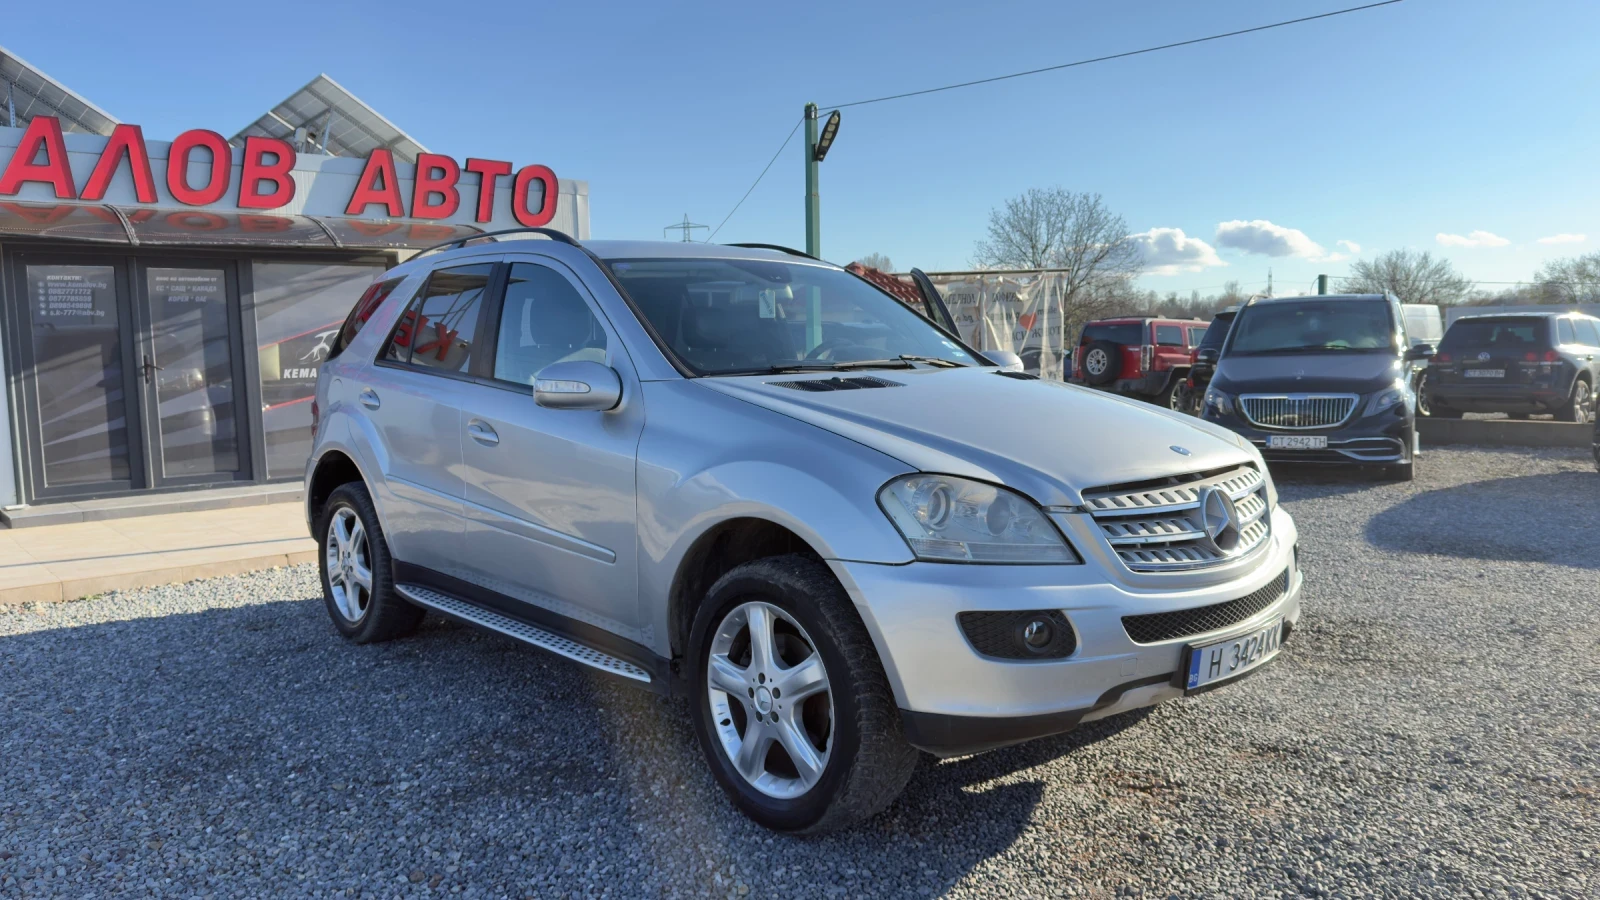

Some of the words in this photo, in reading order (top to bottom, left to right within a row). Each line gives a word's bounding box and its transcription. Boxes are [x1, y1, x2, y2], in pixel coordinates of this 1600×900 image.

[344, 148, 559, 228] АВТО
[1272, 437, 1284, 446] CT
[1287, 437, 1311, 447] 2942
[1313, 437, 1326, 446] TH
[1208, 648, 1223, 678] H
